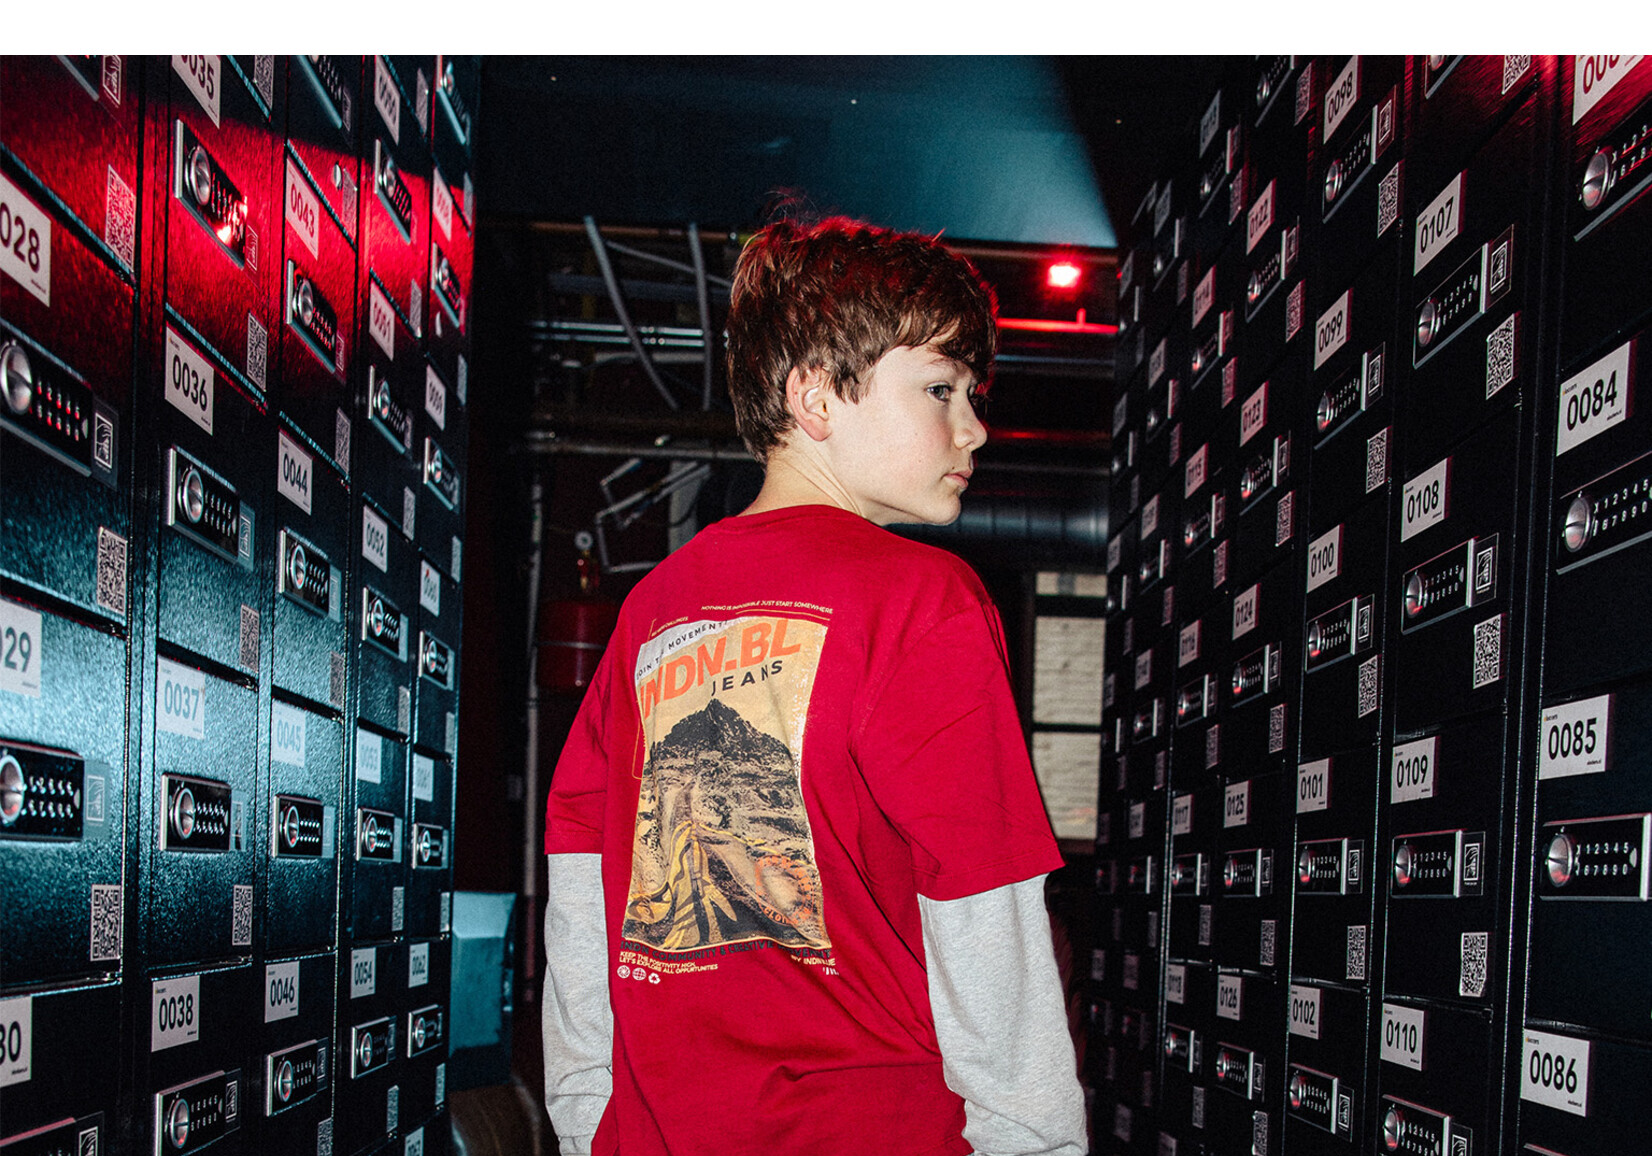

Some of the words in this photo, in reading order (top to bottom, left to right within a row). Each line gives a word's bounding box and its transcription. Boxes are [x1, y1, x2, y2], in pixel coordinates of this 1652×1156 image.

[181, 55, 215, 100] 035
[1327, 71, 1353, 124] 0098
[288, 178, 316, 238] 0043
[1420, 196, 1454, 254] 0107
[0, 202, 40, 273] 028
[1319, 310, 1343, 352] 0099
[172, 353, 208, 412] 0036
[1566, 369, 1617, 431] 0084
[1241, 398, 1261, 433] 0123
[283, 454, 308, 496] 0044
[1407, 479, 1439, 524] 0108
[367, 523, 385, 558] 0052
[1311, 541, 1335, 578] 0100
[775, 600, 793, 608] START
[793, 601, 834, 615] SOMEWHERE
[0, 625, 32, 674] 29
[711, 660, 783, 697] JEANS
[164, 681, 199, 722] 0037
[276, 719, 302, 754] 0045
[1549, 717, 1598, 761] 0085
[1300, 774, 1323, 801] 0101
[1396, 754, 1428, 788] 0109
[620, 940, 649, 955] INDN
[652, 947, 717, 962] COMMUNITY
[353, 963, 373, 988] 0054
[663, 967, 675, 975] ALL
[269, 976, 296, 1007] 0046
[158, 993, 194, 1032] 0038
[1292, 997, 1315, 1026] 0102
[1386, 1019, 1418, 1054] 0110
[1529, 1049, 1578, 1094] 0086
